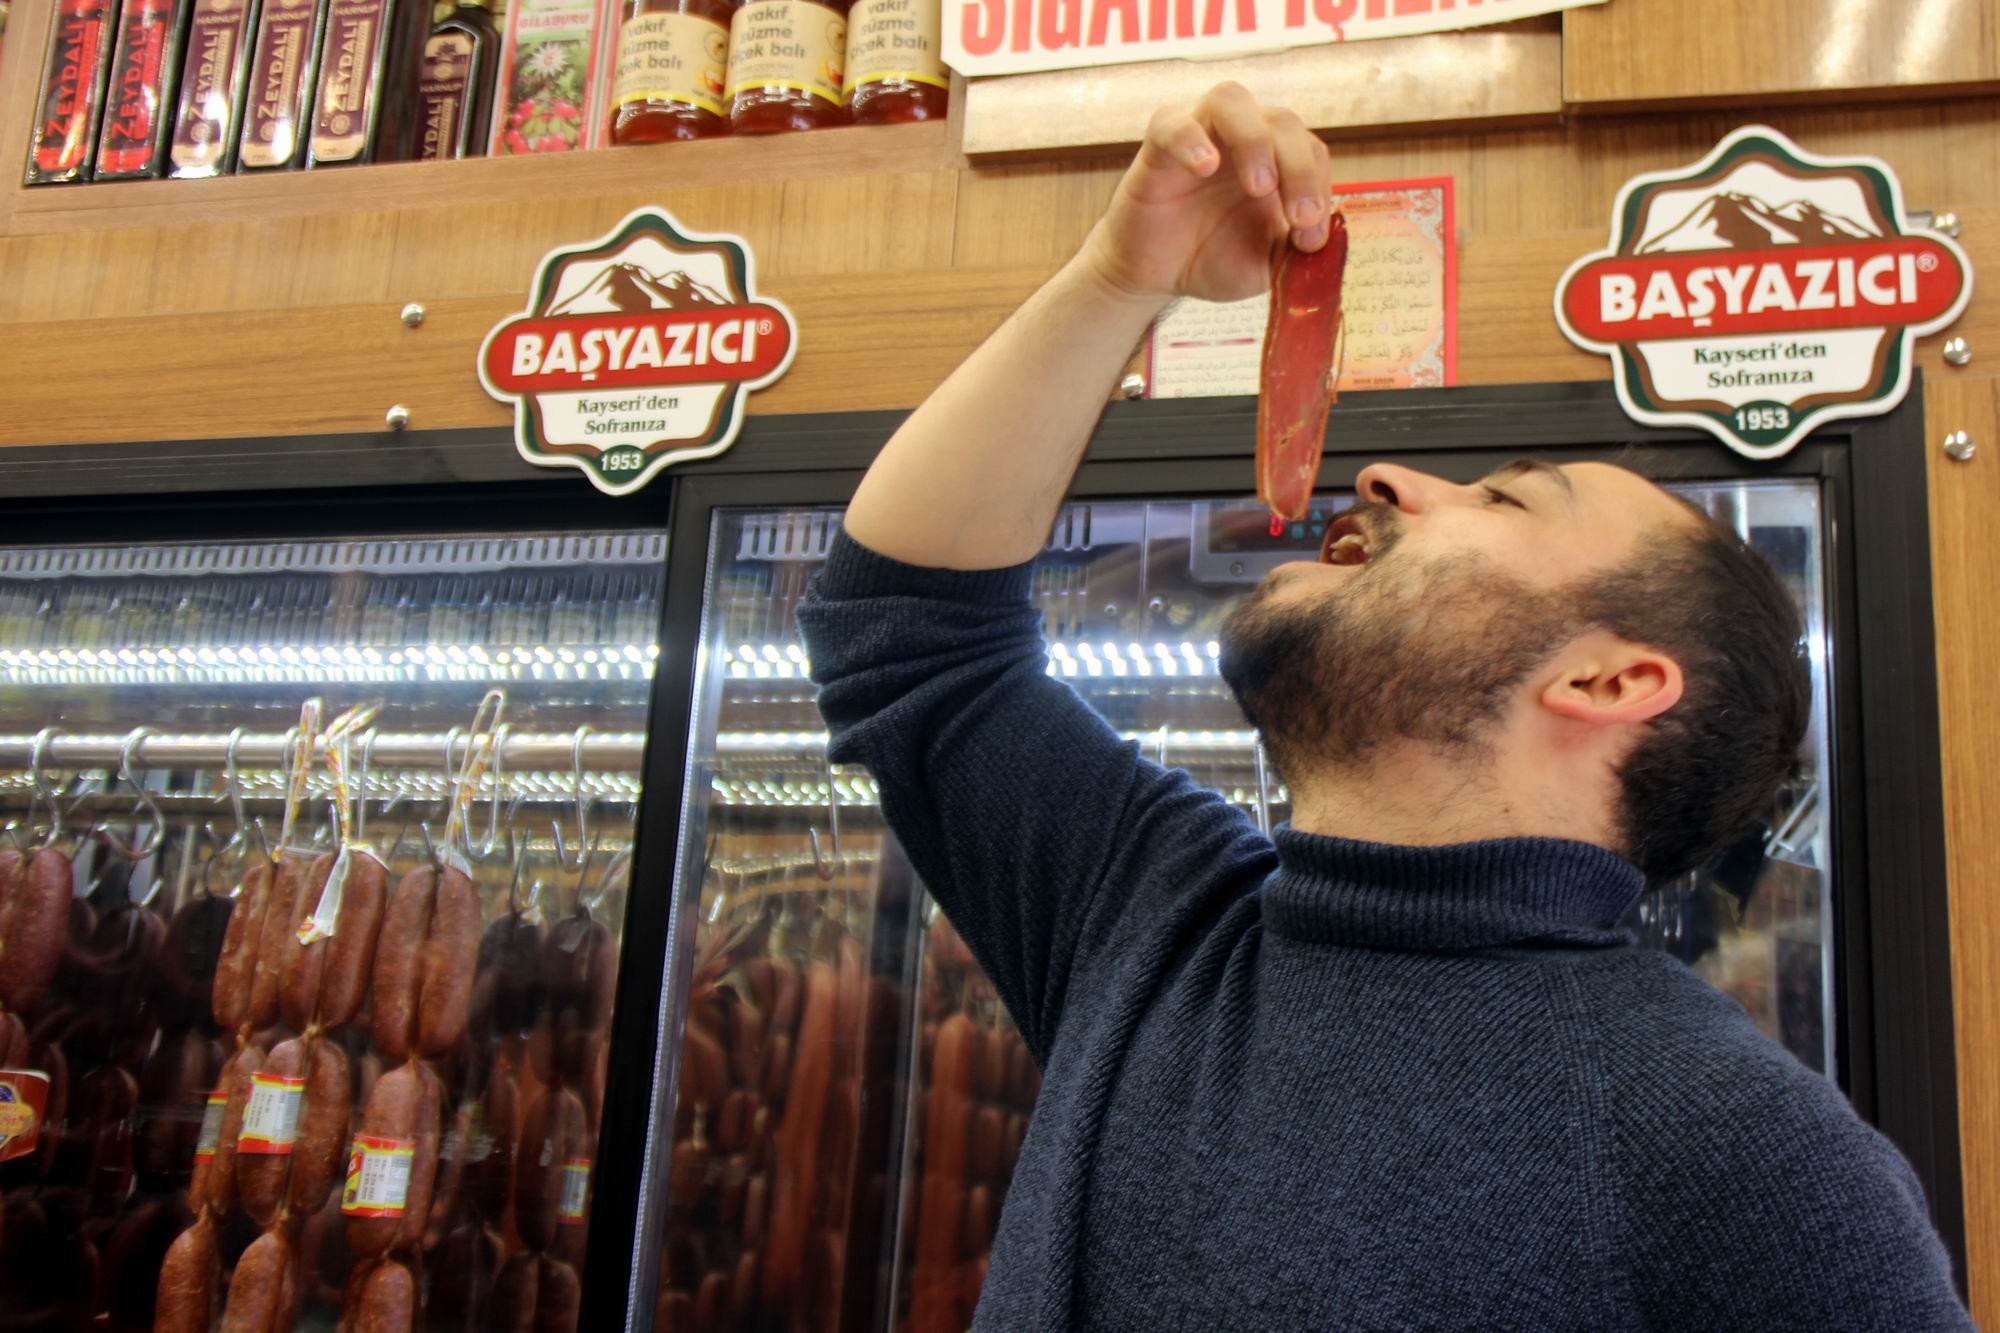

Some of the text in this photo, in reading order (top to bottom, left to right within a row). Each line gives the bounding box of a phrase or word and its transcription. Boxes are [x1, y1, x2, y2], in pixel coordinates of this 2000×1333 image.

[256, 24, 290, 120] ZEYDALI
[333, 17, 360, 112] ZEYDALI
[46, 20, 85, 138] ZEYDALI
[1693, 341, 1827, 368] Kayseri'den
[1706, 369, 1814, 389] Sofranıza
[576, 395, 679, 416] Kayseri'den
[583, 417, 666, 436] Sofranıza
[1735, 408, 1791, 431] 1953
[600, 452, 642, 472] 1953
